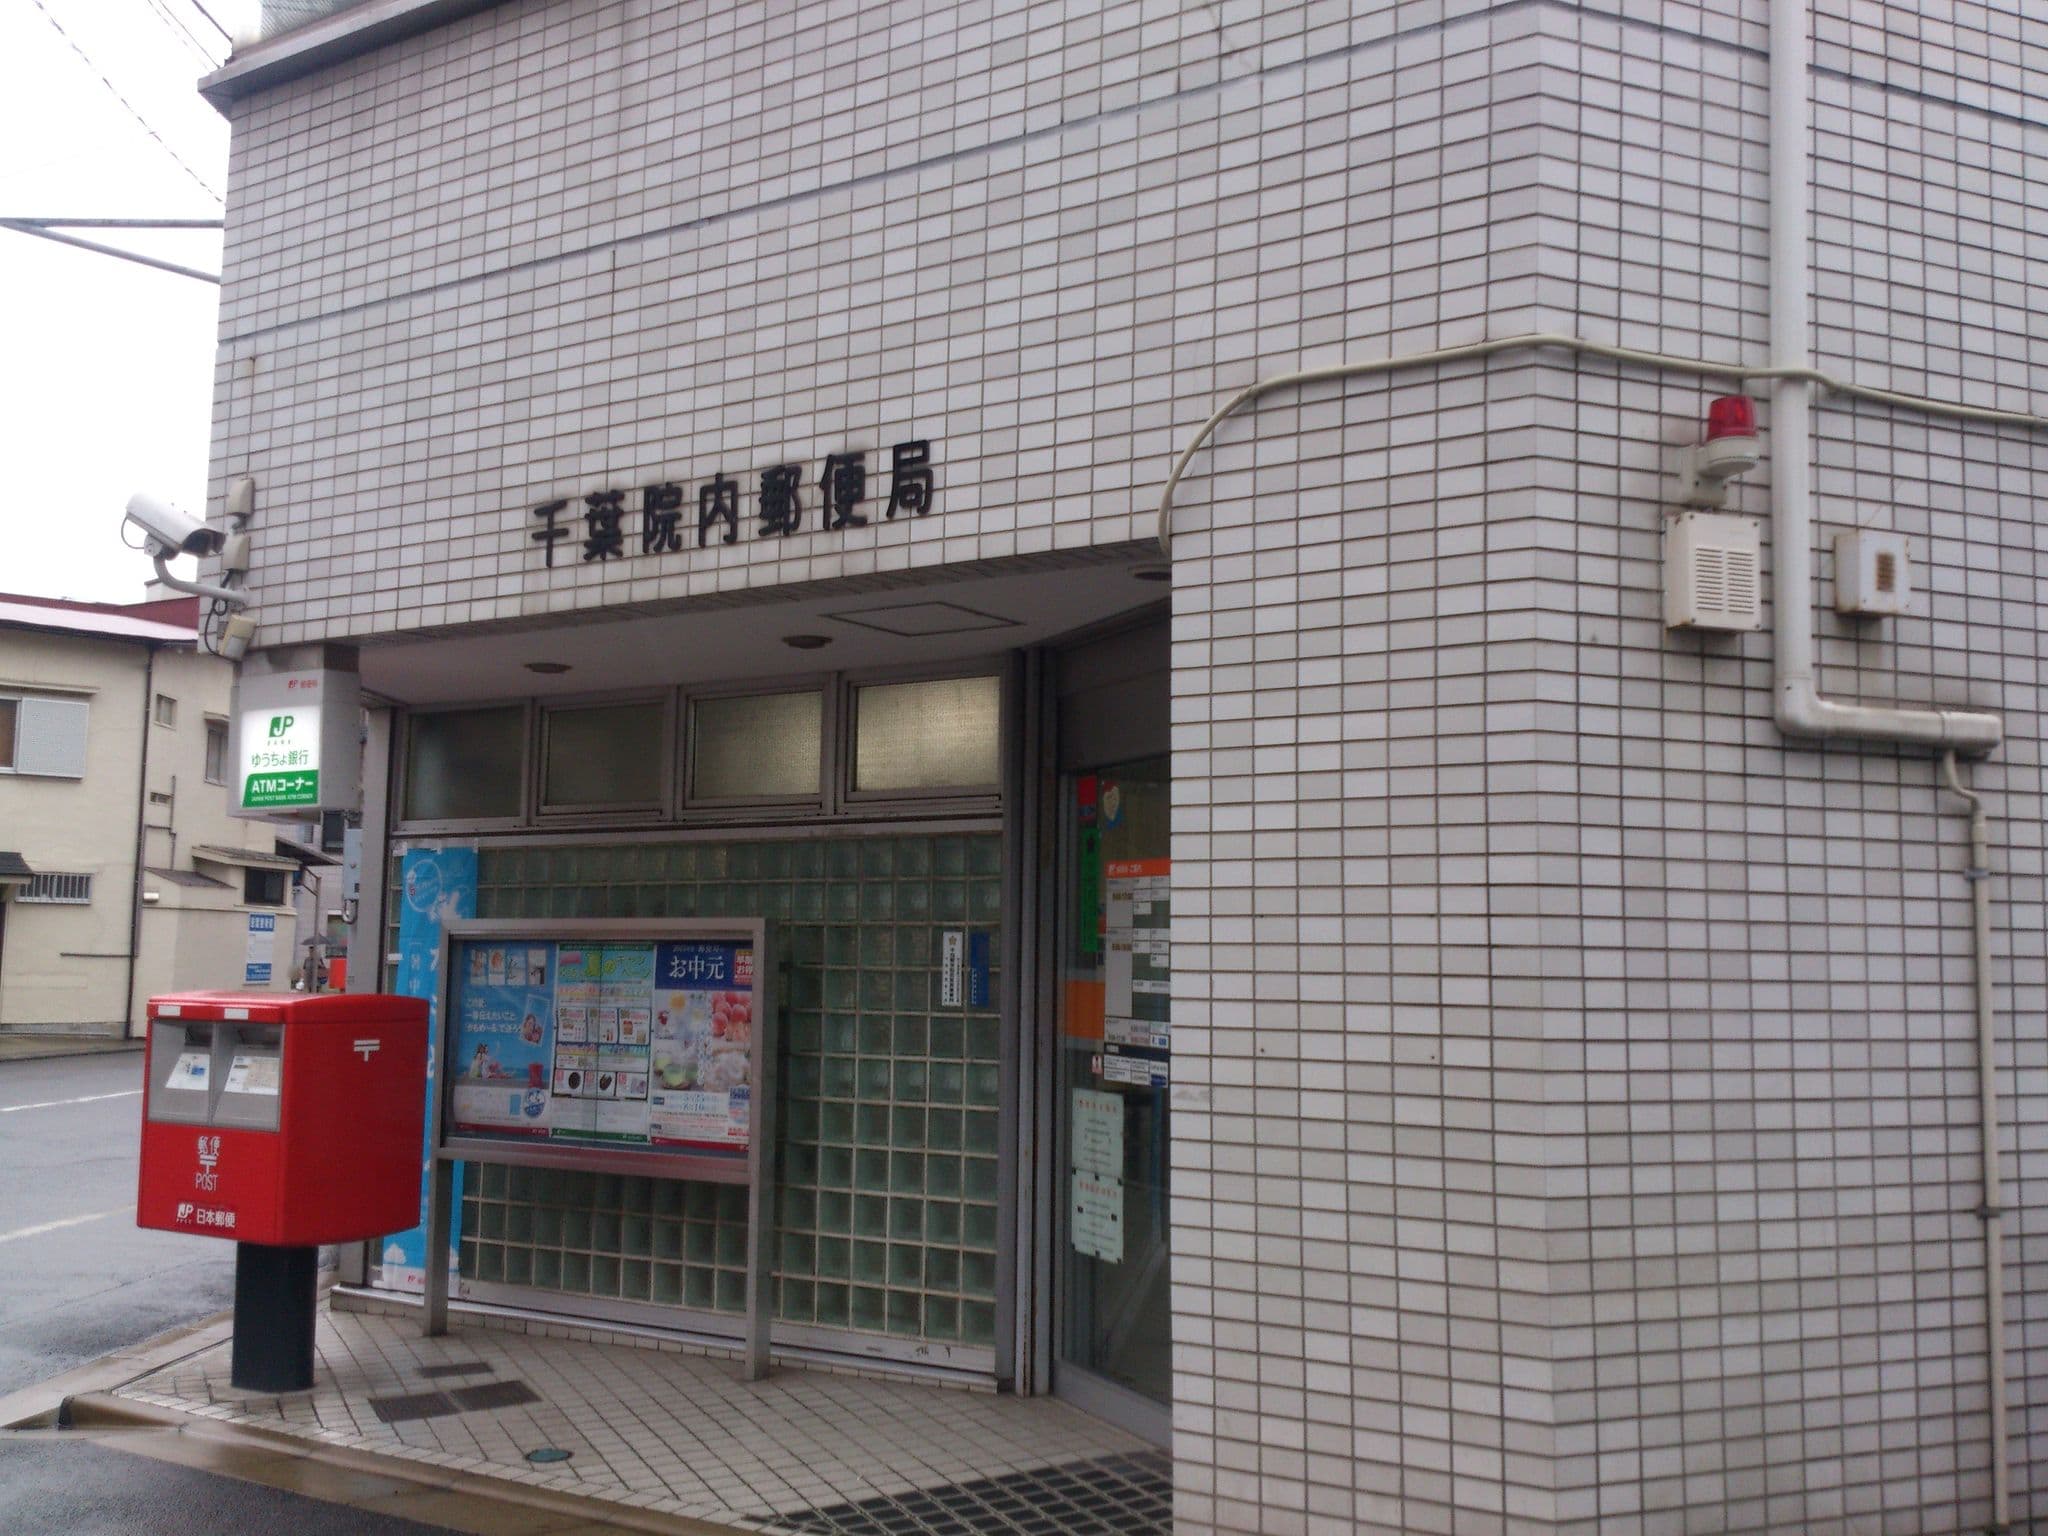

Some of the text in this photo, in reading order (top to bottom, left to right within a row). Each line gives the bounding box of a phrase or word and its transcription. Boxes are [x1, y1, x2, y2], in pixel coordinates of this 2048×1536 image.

[531, 439, 935, 568] 千葉院内郵便局
[269, 715, 294, 738] JP
[251, 749, 309, 768] ゆうちょ銀行
[251, 777, 314, 794] ATMコーナー
[669, 955, 725, 981] お中元
[198, 1136, 221, 1156] 郵便
[195, 1172, 218, 1192] POST
[177, 1202, 236, 1229] JP 日本郵便
